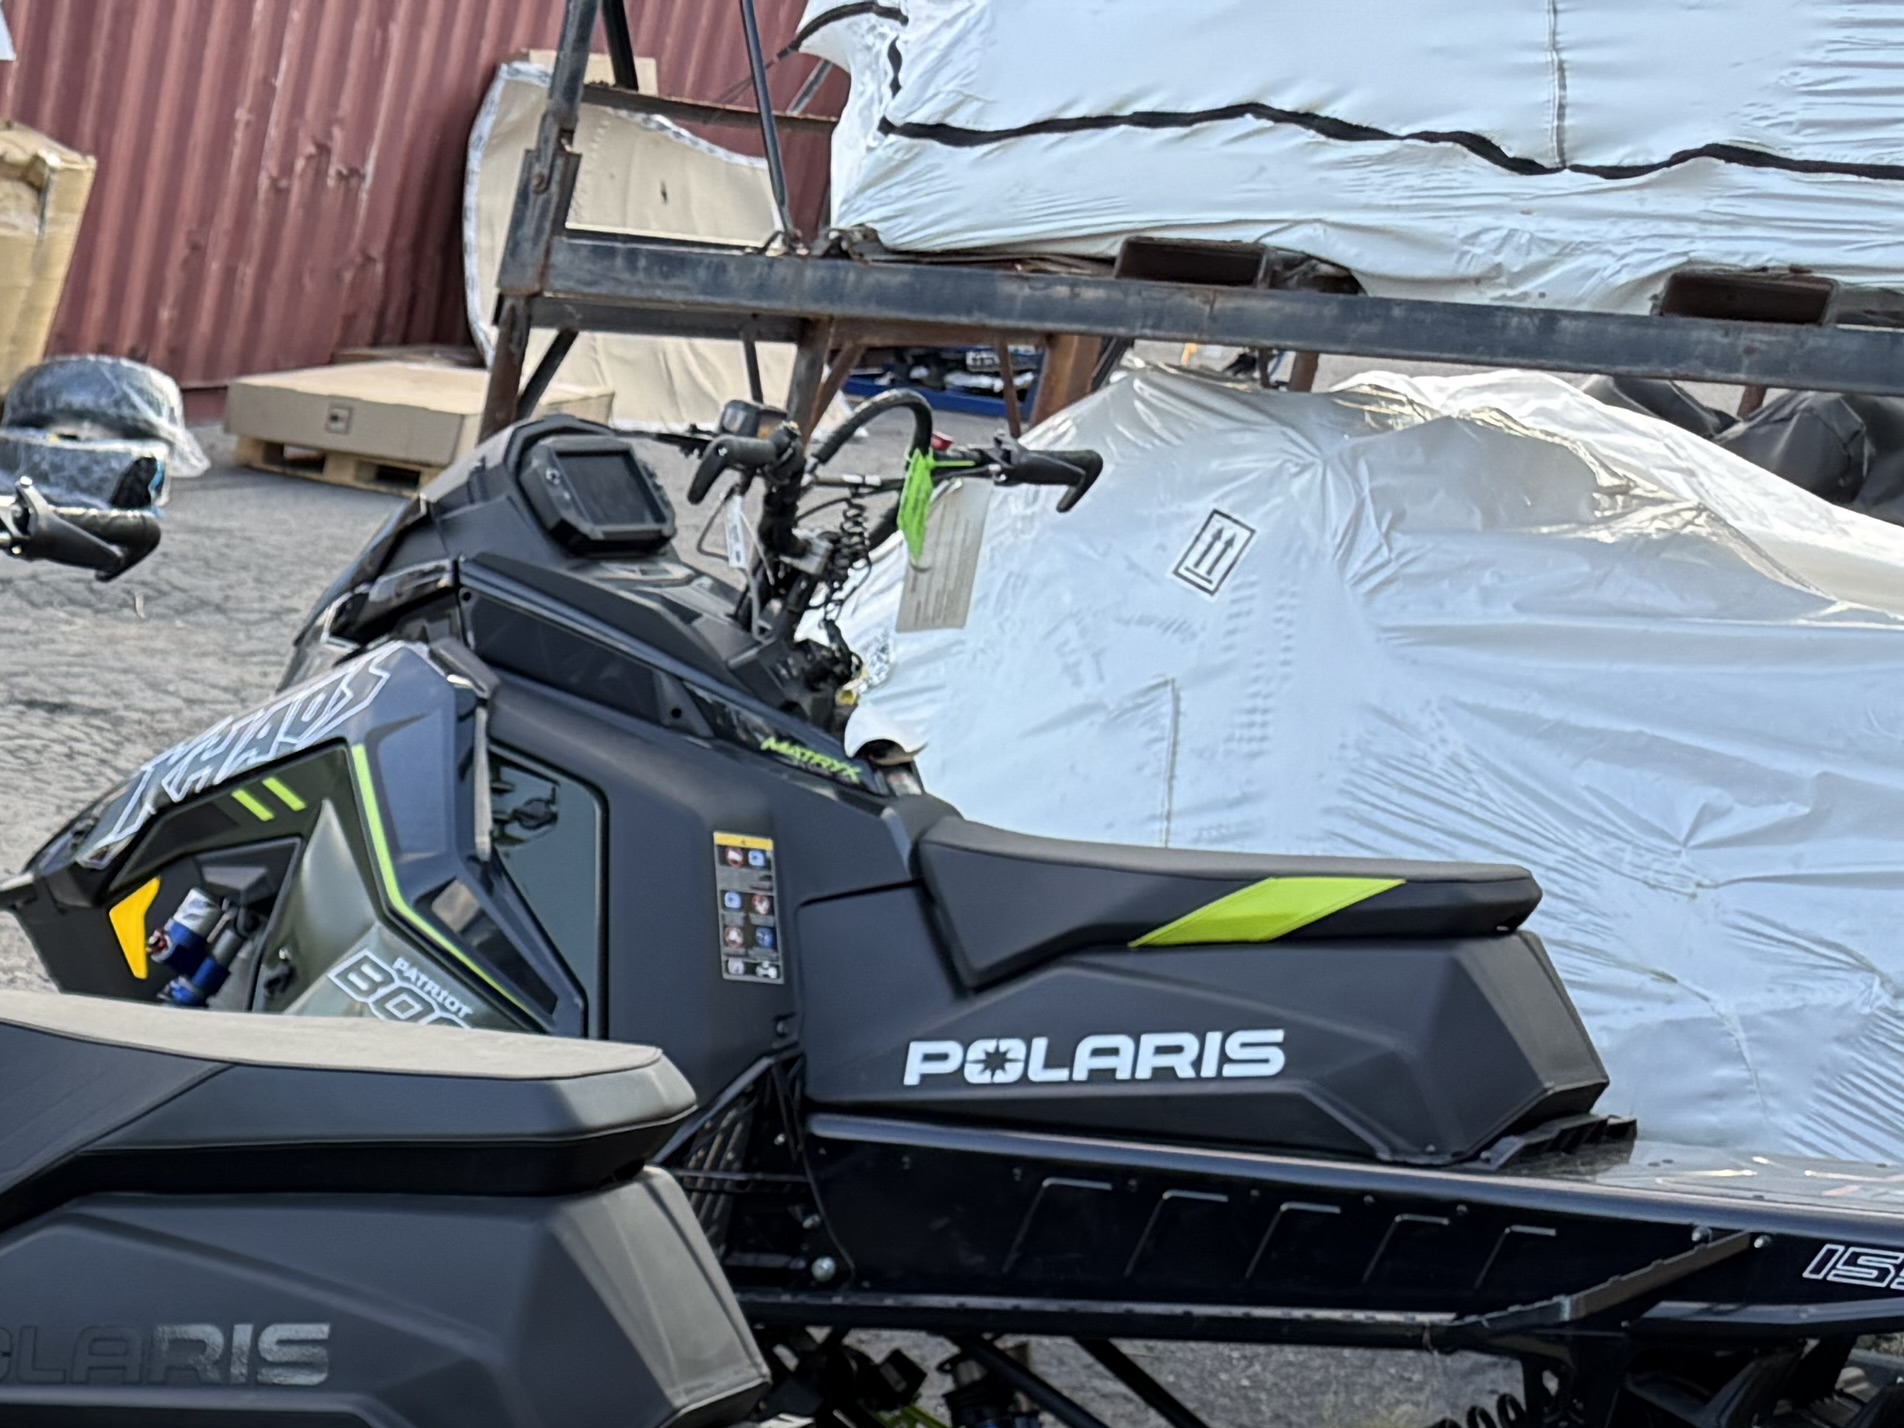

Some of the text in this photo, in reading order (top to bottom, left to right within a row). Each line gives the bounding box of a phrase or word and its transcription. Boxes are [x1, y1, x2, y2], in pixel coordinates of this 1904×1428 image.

[392, 957, 473, 1018] PATRIOT
[904, 1028, 1286, 1086] POLARIS
[1802, 1243, 1904, 1291] 15
